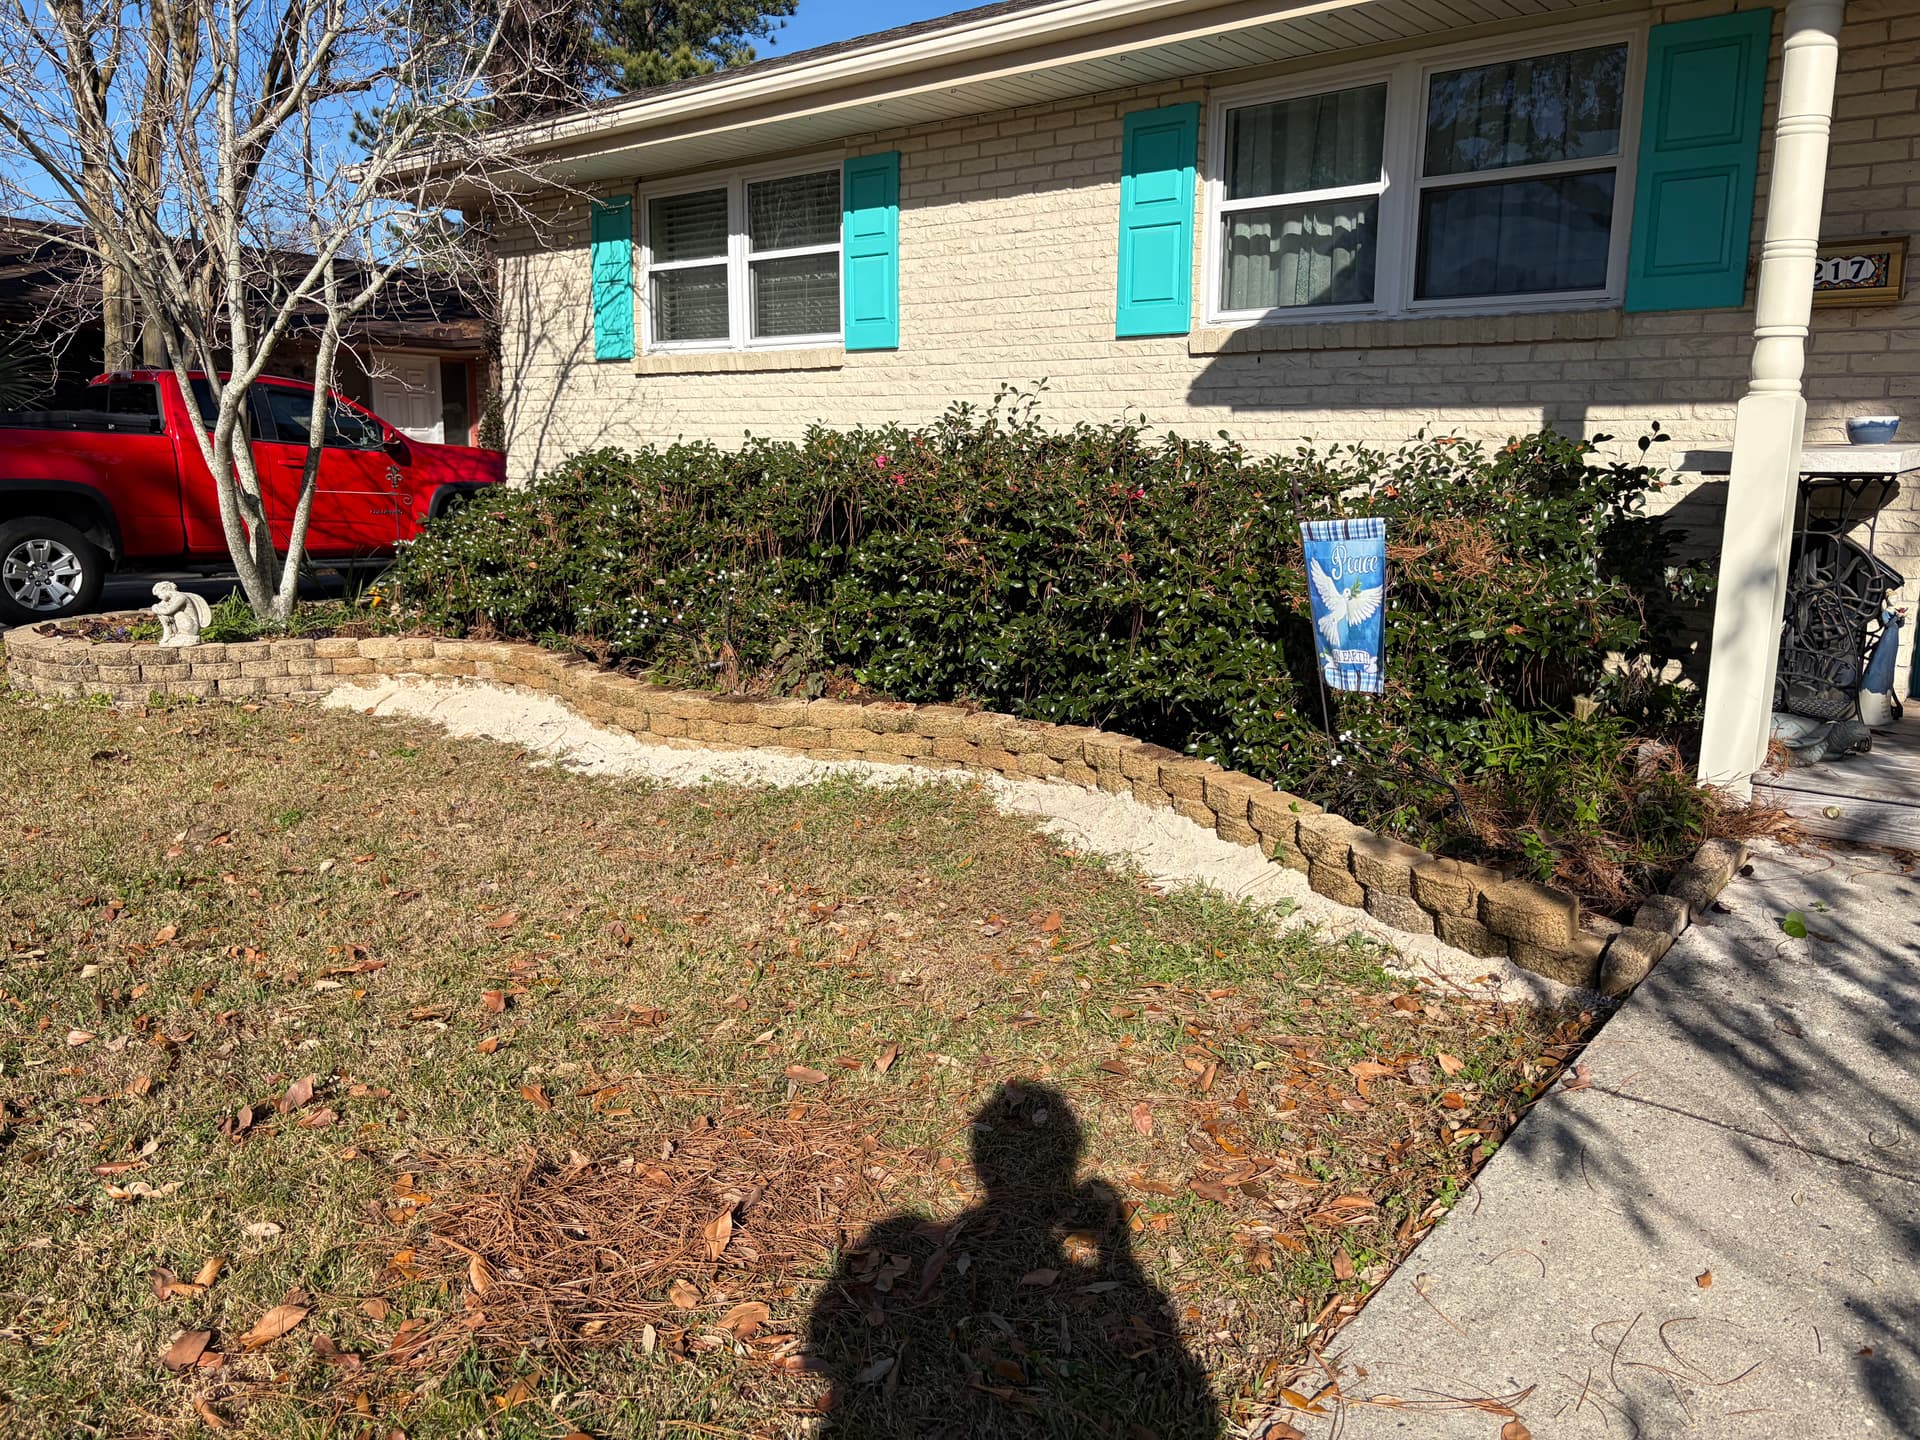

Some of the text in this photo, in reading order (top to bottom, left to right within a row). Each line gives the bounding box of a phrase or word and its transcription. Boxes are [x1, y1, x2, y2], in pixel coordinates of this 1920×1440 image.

[1814, 260, 1866, 281] 217
[1331, 544, 1378, 580] Peace
[1342, 650, 1370, 664] EARTH
